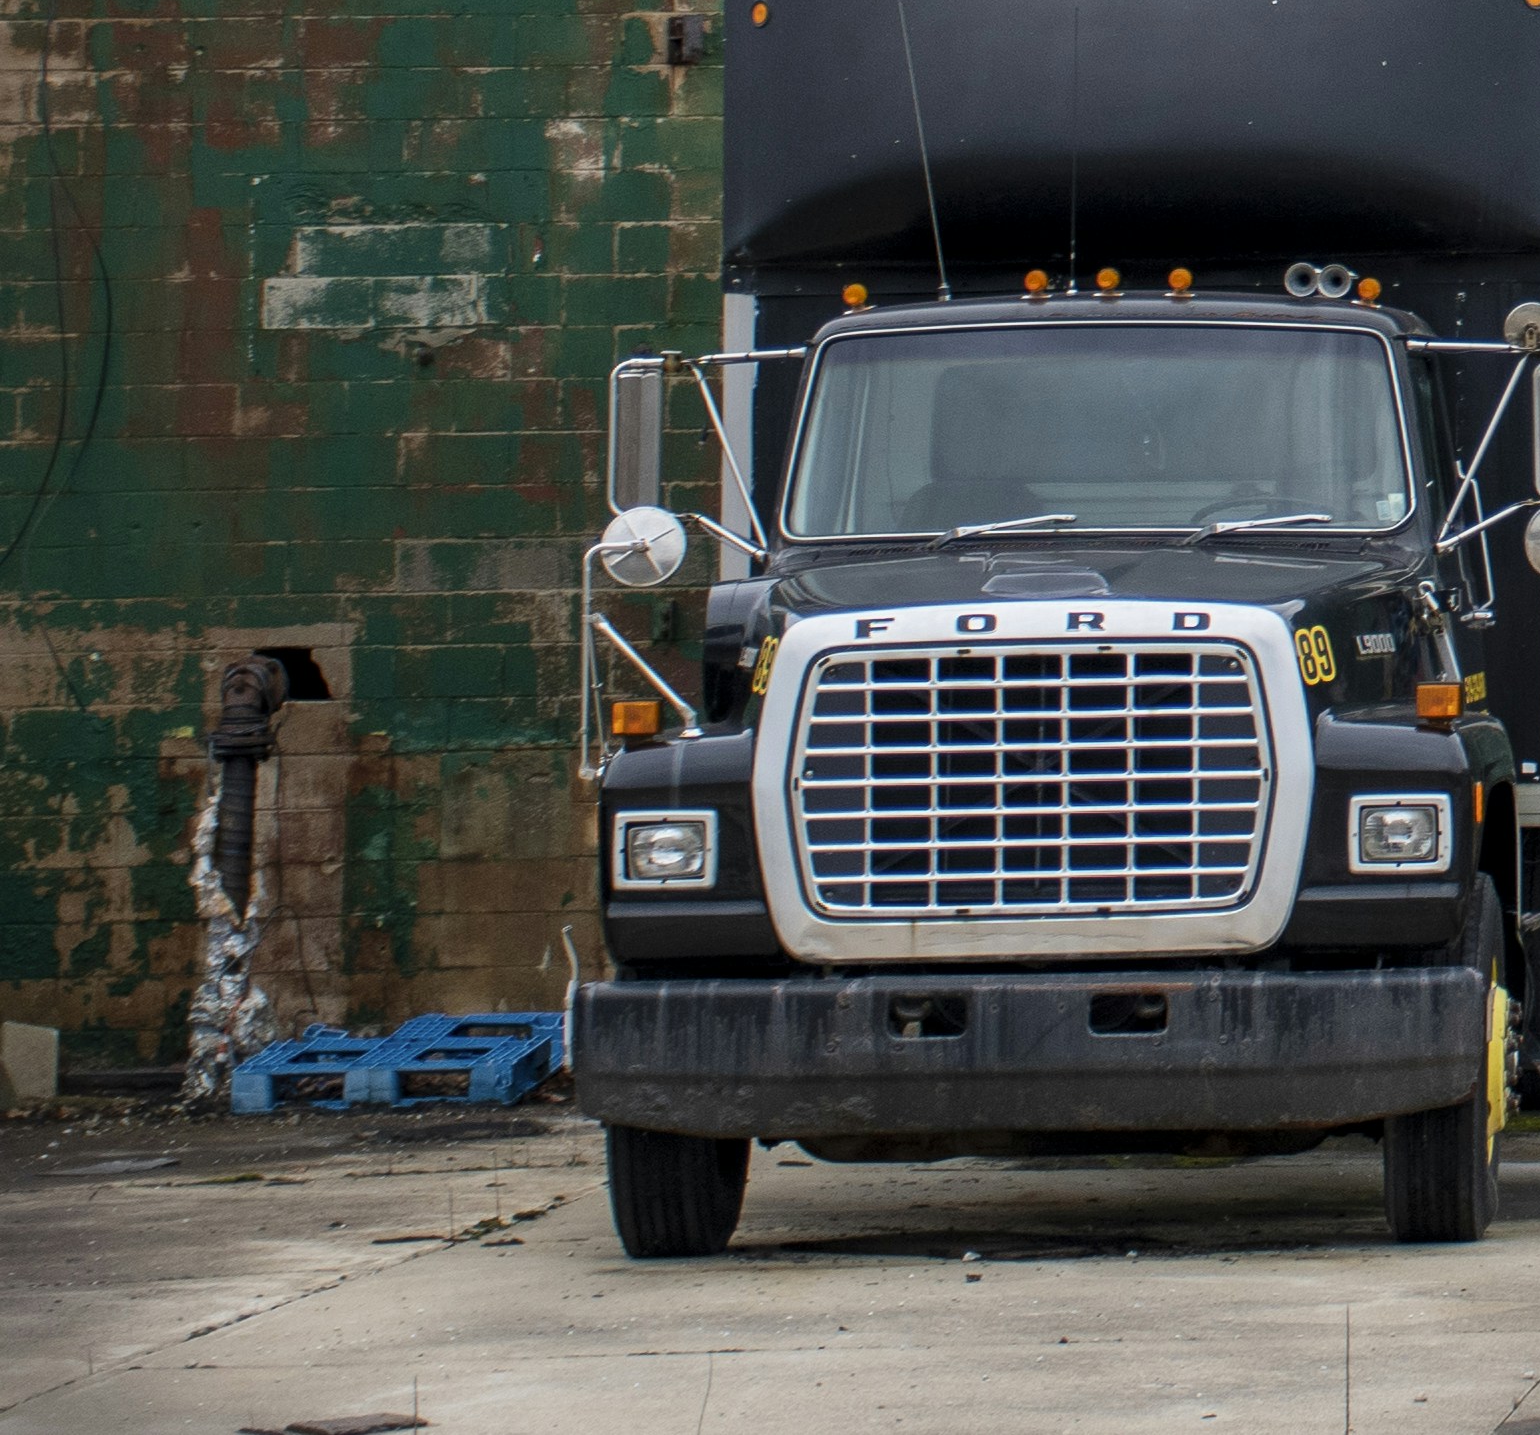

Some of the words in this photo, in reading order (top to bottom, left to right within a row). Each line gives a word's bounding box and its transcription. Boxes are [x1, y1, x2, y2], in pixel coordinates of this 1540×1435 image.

[854, 610, 1212, 640] FORD
[1294, 624, 1337, 686] 89
[1355, 632, 1397, 655] L9000
